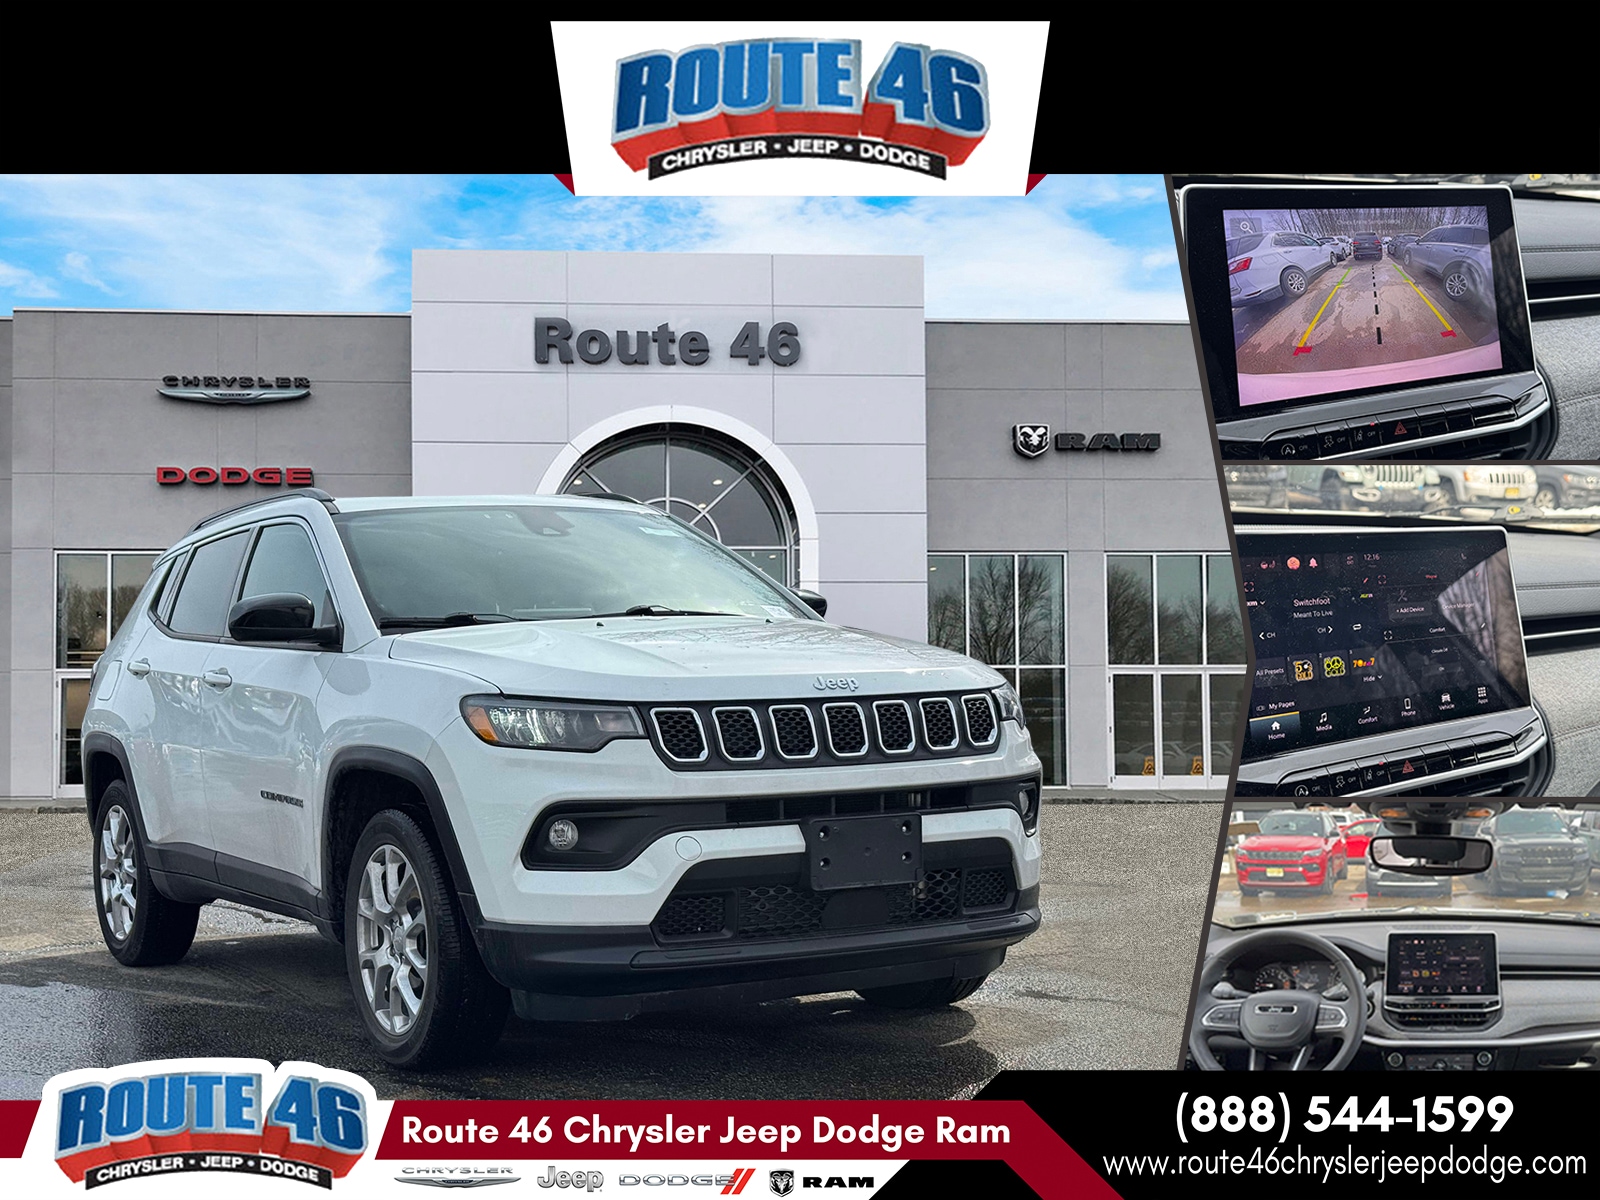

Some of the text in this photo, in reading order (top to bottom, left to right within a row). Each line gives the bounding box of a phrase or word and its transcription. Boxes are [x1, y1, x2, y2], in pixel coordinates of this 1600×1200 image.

[534, 317, 801, 367] Route 46
[162, 375, 311, 388] CHRYSLER
[1055, 433, 1161, 451] RAM
[156, 466, 313, 485] DODGE
[1293, 598, 1331, 607] Switchfoot
[1264, 668, 1285, 676] Presets
[813, 676, 859, 692] Jeep
[1268, 701, 1295, 710] My Pages
[1358, 716, 1378, 725] Comfort
[1316, 724, 1332, 732] Media
[1268, 732, 1286, 740] Home
